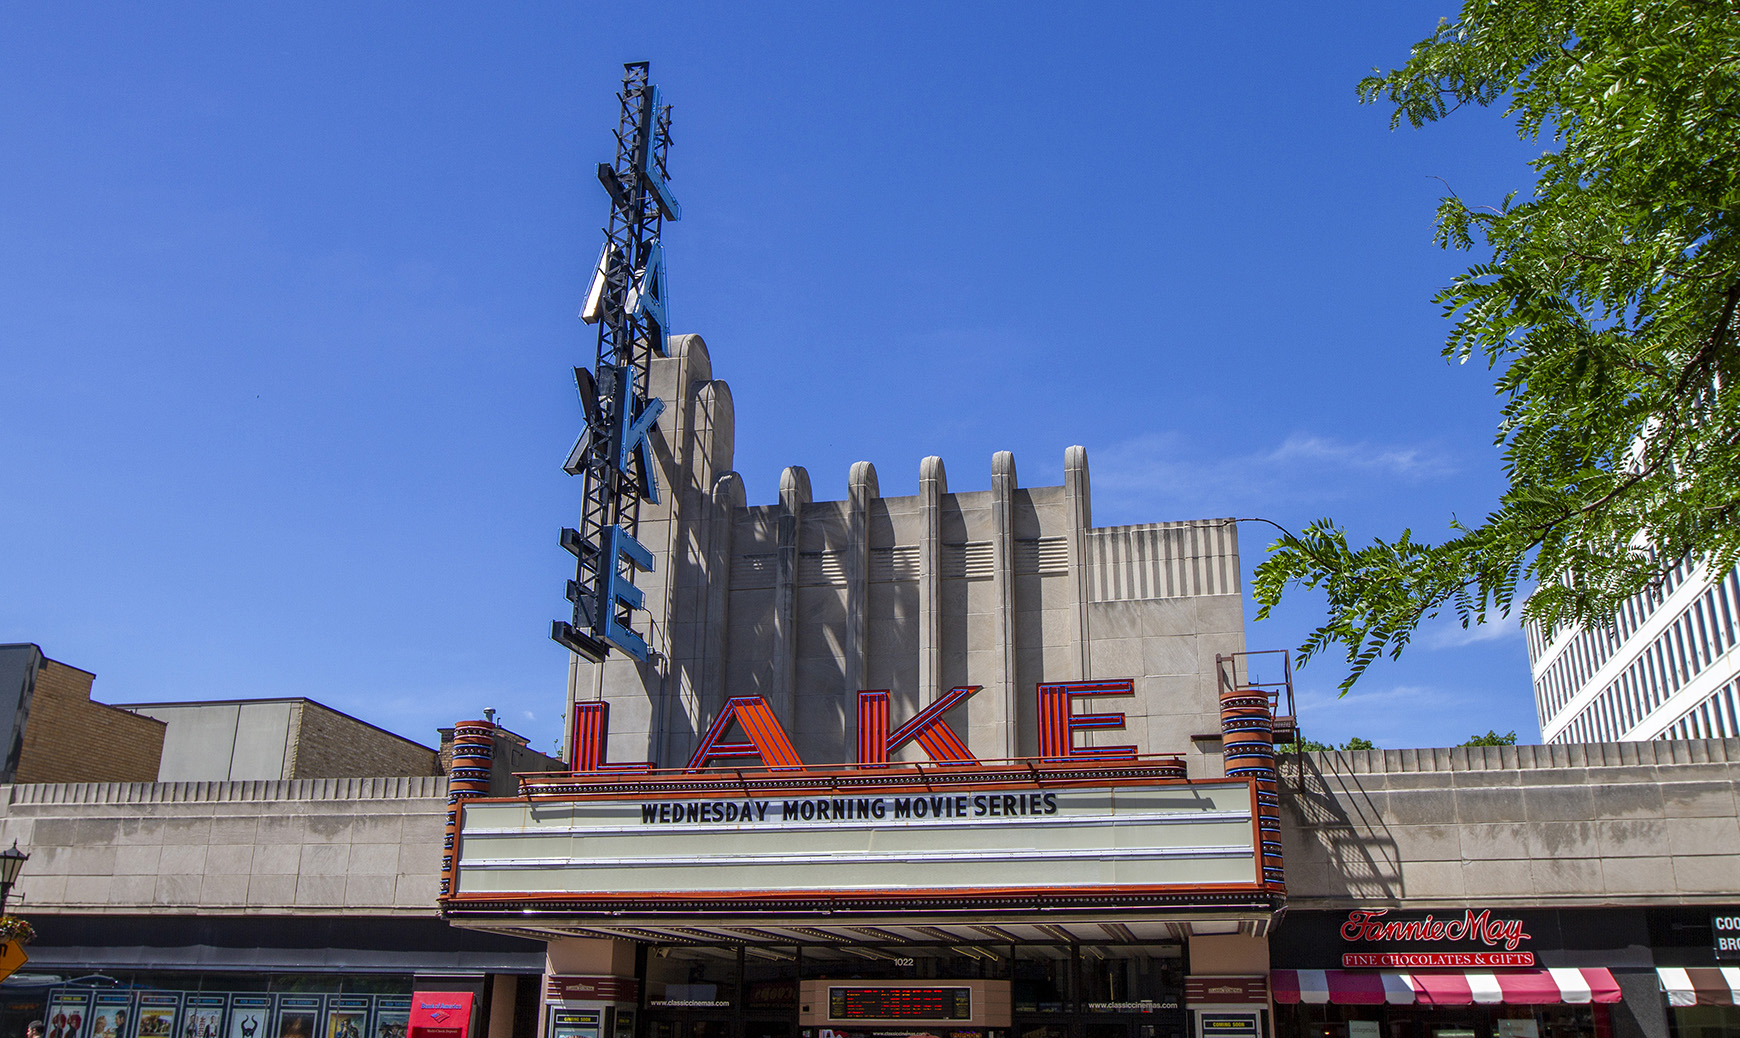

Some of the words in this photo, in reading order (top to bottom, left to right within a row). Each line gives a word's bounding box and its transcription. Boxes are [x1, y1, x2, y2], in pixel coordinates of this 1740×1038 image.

[600, 84, 682, 663] LAKE
[570, 677, 1139, 777] LAKE
[641, 800, 769, 824] WEDNESDAY
[782, 798, 886, 821] MORNING
[894, 796, 968, 819] MOVIE
[973, 793, 1057, 816] SERIES
[1340, 908, 1446, 942] Fannie
[1445, 908, 1532, 951] May
[893, 957, 914, 967] 1022
[1345, 955, 1378, 966] FINE
[1381, 954, 1472, 966] CHOCOLATES
[1474, 953, 1486, 965] &
[1489, 953, 1533, 965] GIFTS
[650, 999, 730, 1008] www.classiccinemas.com
[1088, 1001, 1178, 1010] www.classiccinemas.com
